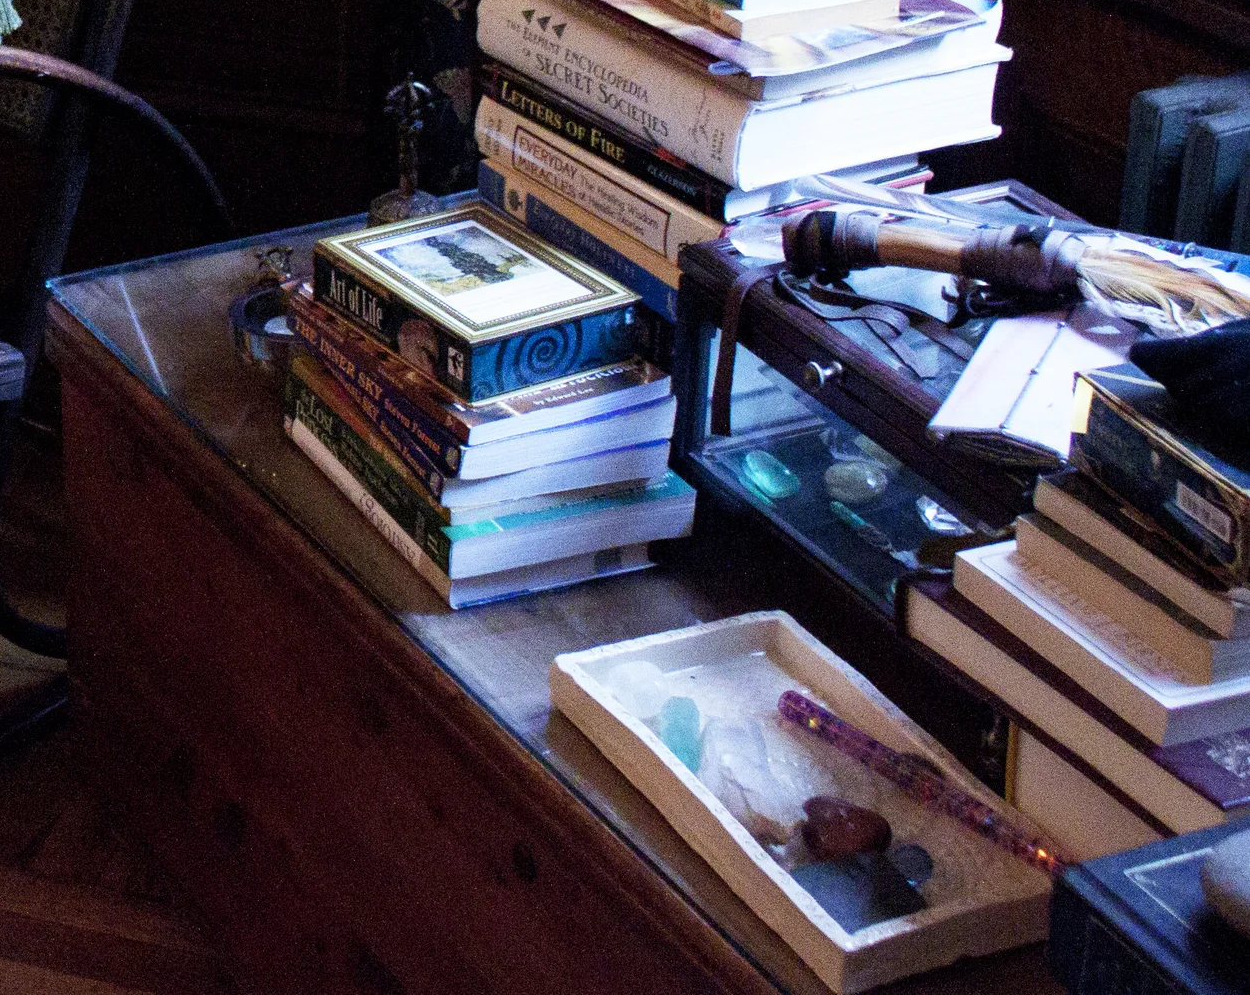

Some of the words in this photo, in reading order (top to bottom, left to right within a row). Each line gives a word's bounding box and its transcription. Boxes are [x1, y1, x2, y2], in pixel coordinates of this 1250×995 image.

[523, 24, 561, 55] ELEMENT
[564, 48, 651, 104] ENCYCLOPEDIA
[535, 52, 594, 96] SECRET
[597, 85, 670, 138] SOCIETIES
[501, 80, 562, 128] LETTERS
[565, 119, 586, 141] OF
[590, 127, 627, 163] FIRE
[518, 135, 579, 177] EVERYDAY
[517, 156, 578, 199] MIRACLES
[627, 200, 660, 230] Wisdom
[329, 269, 347, 307] Art
[348, 284, 361, 315] of
[362, 287, 385, 330] Life
[294, 315, 318, 346] THE
[319, 334, 356, 381] INNER
[358, 368, 384, 402] SKY
